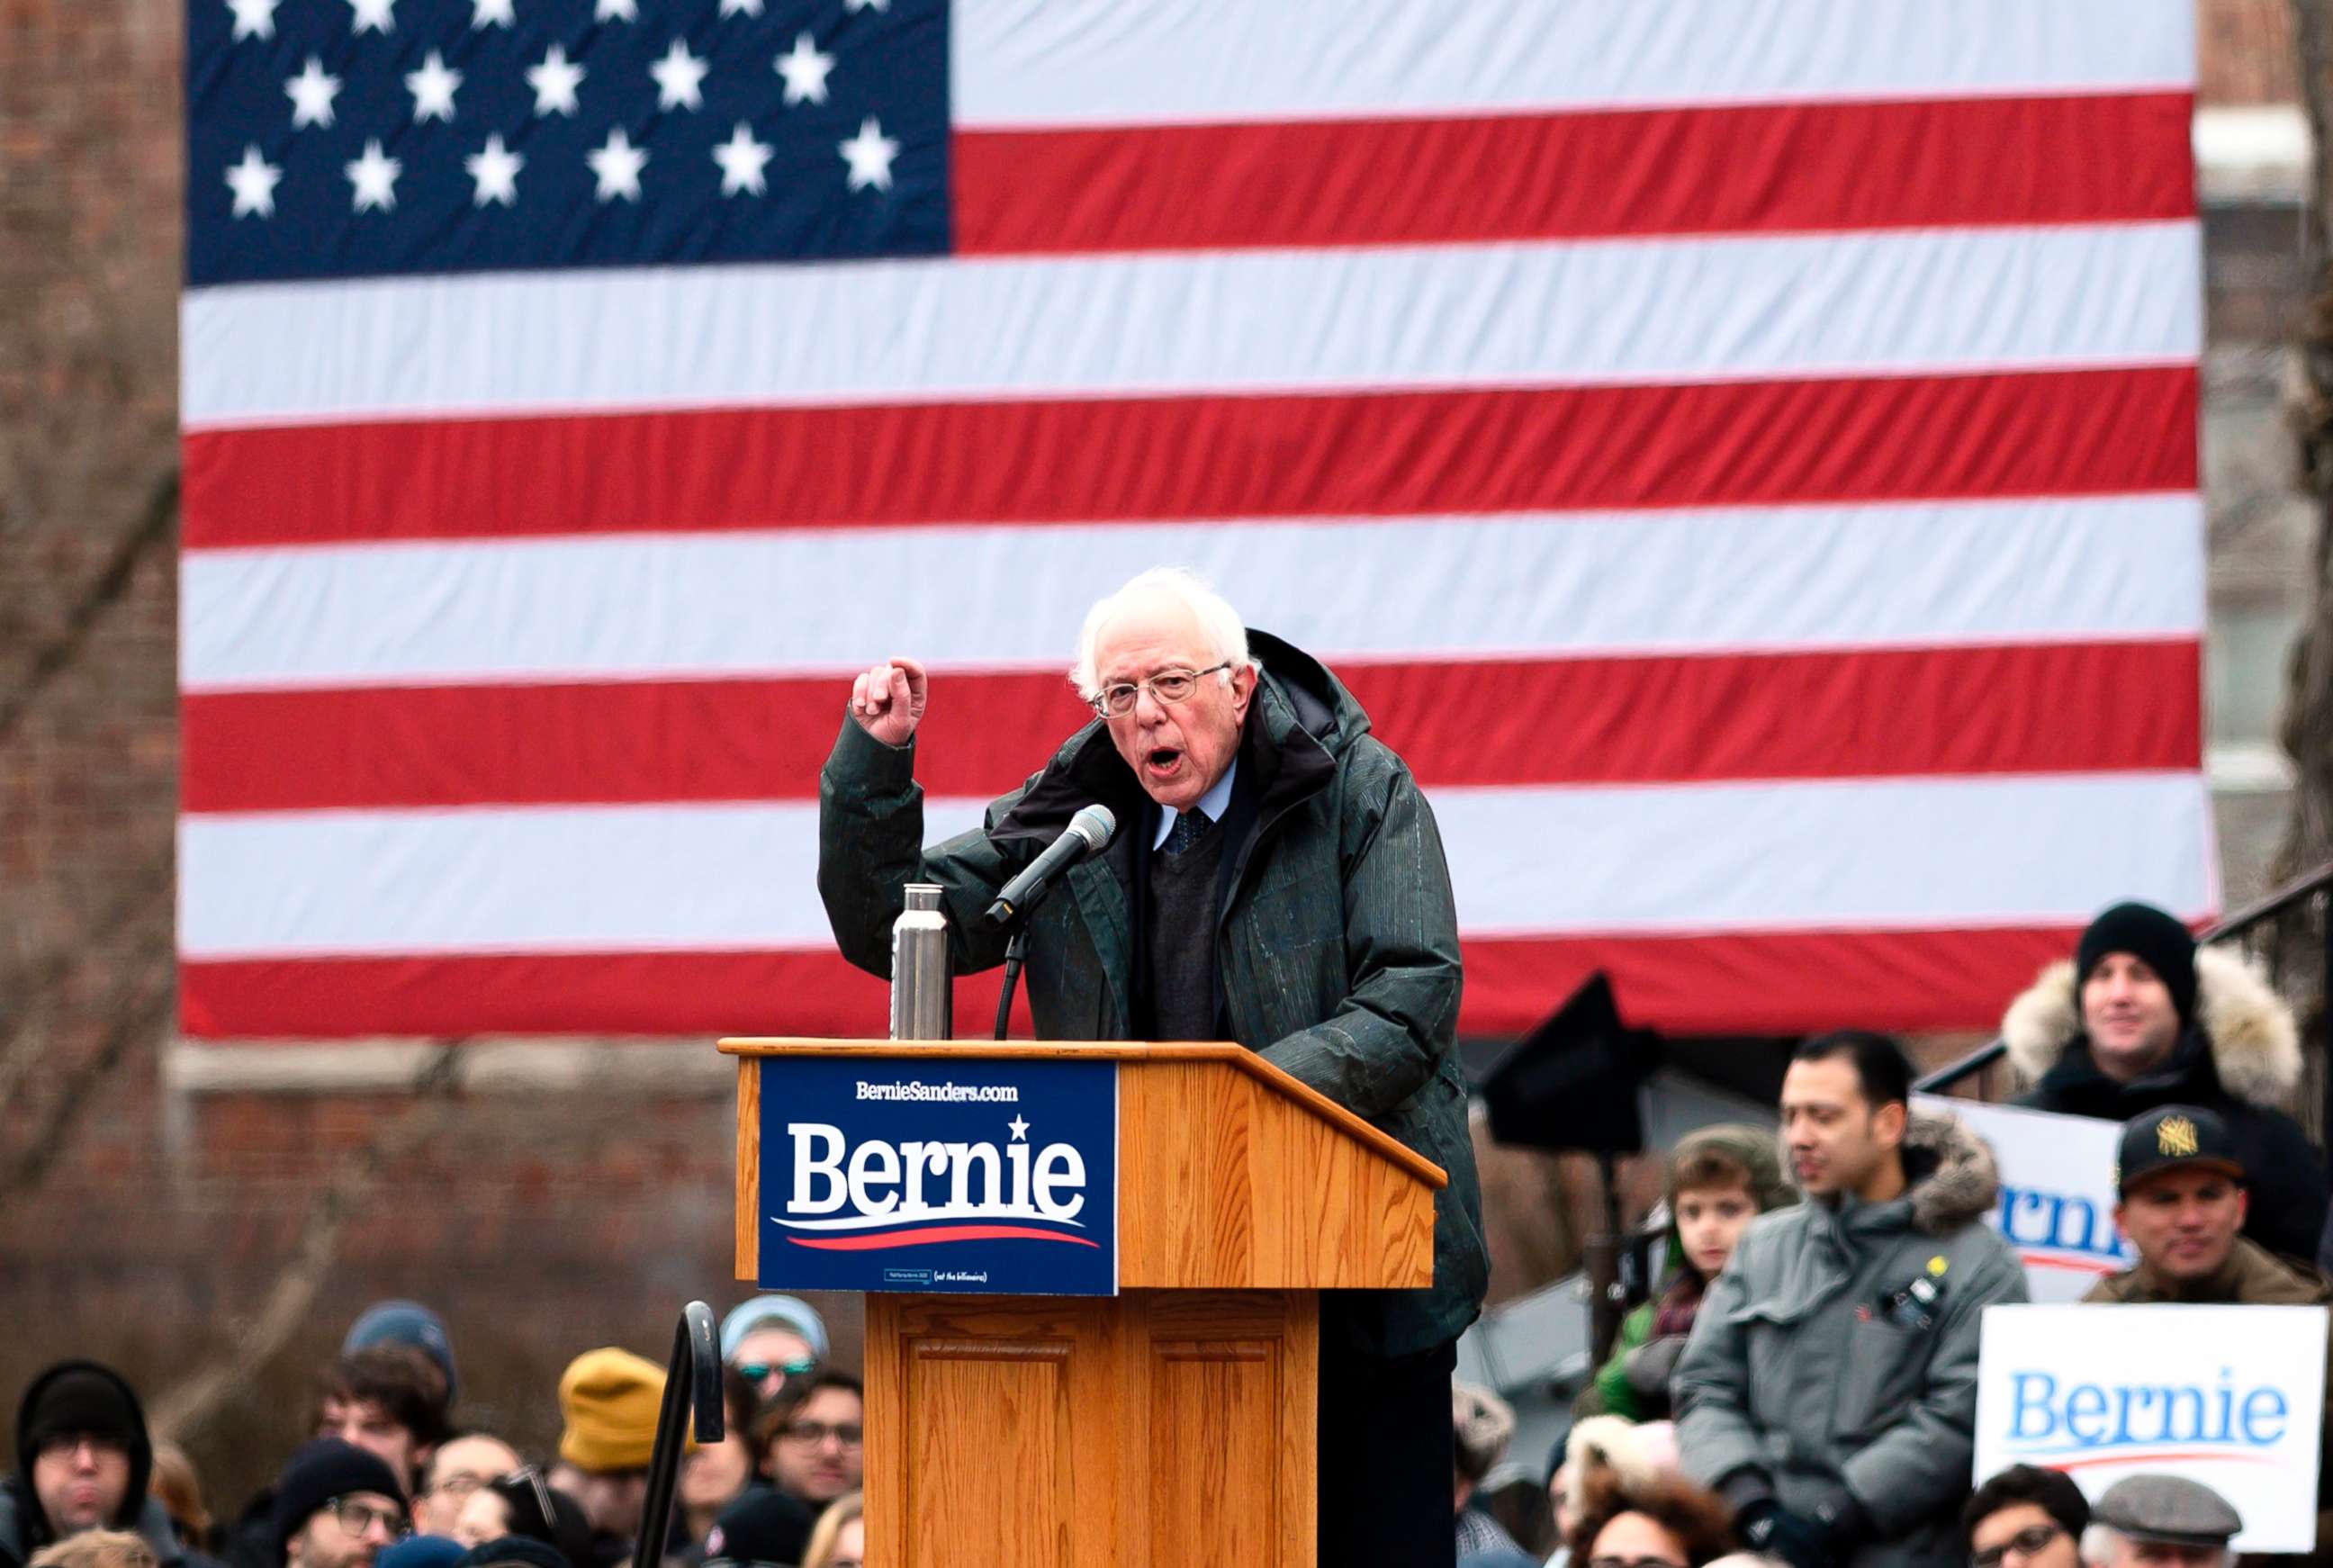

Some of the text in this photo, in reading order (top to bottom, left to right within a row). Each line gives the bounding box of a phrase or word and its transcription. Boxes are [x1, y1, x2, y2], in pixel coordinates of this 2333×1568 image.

[856, 1081, 1019, 1103] BernieSanders.com
[787, 1113, 1086, 1219] Bernie
[2007, 1365, 2289, 1446] Bernie
